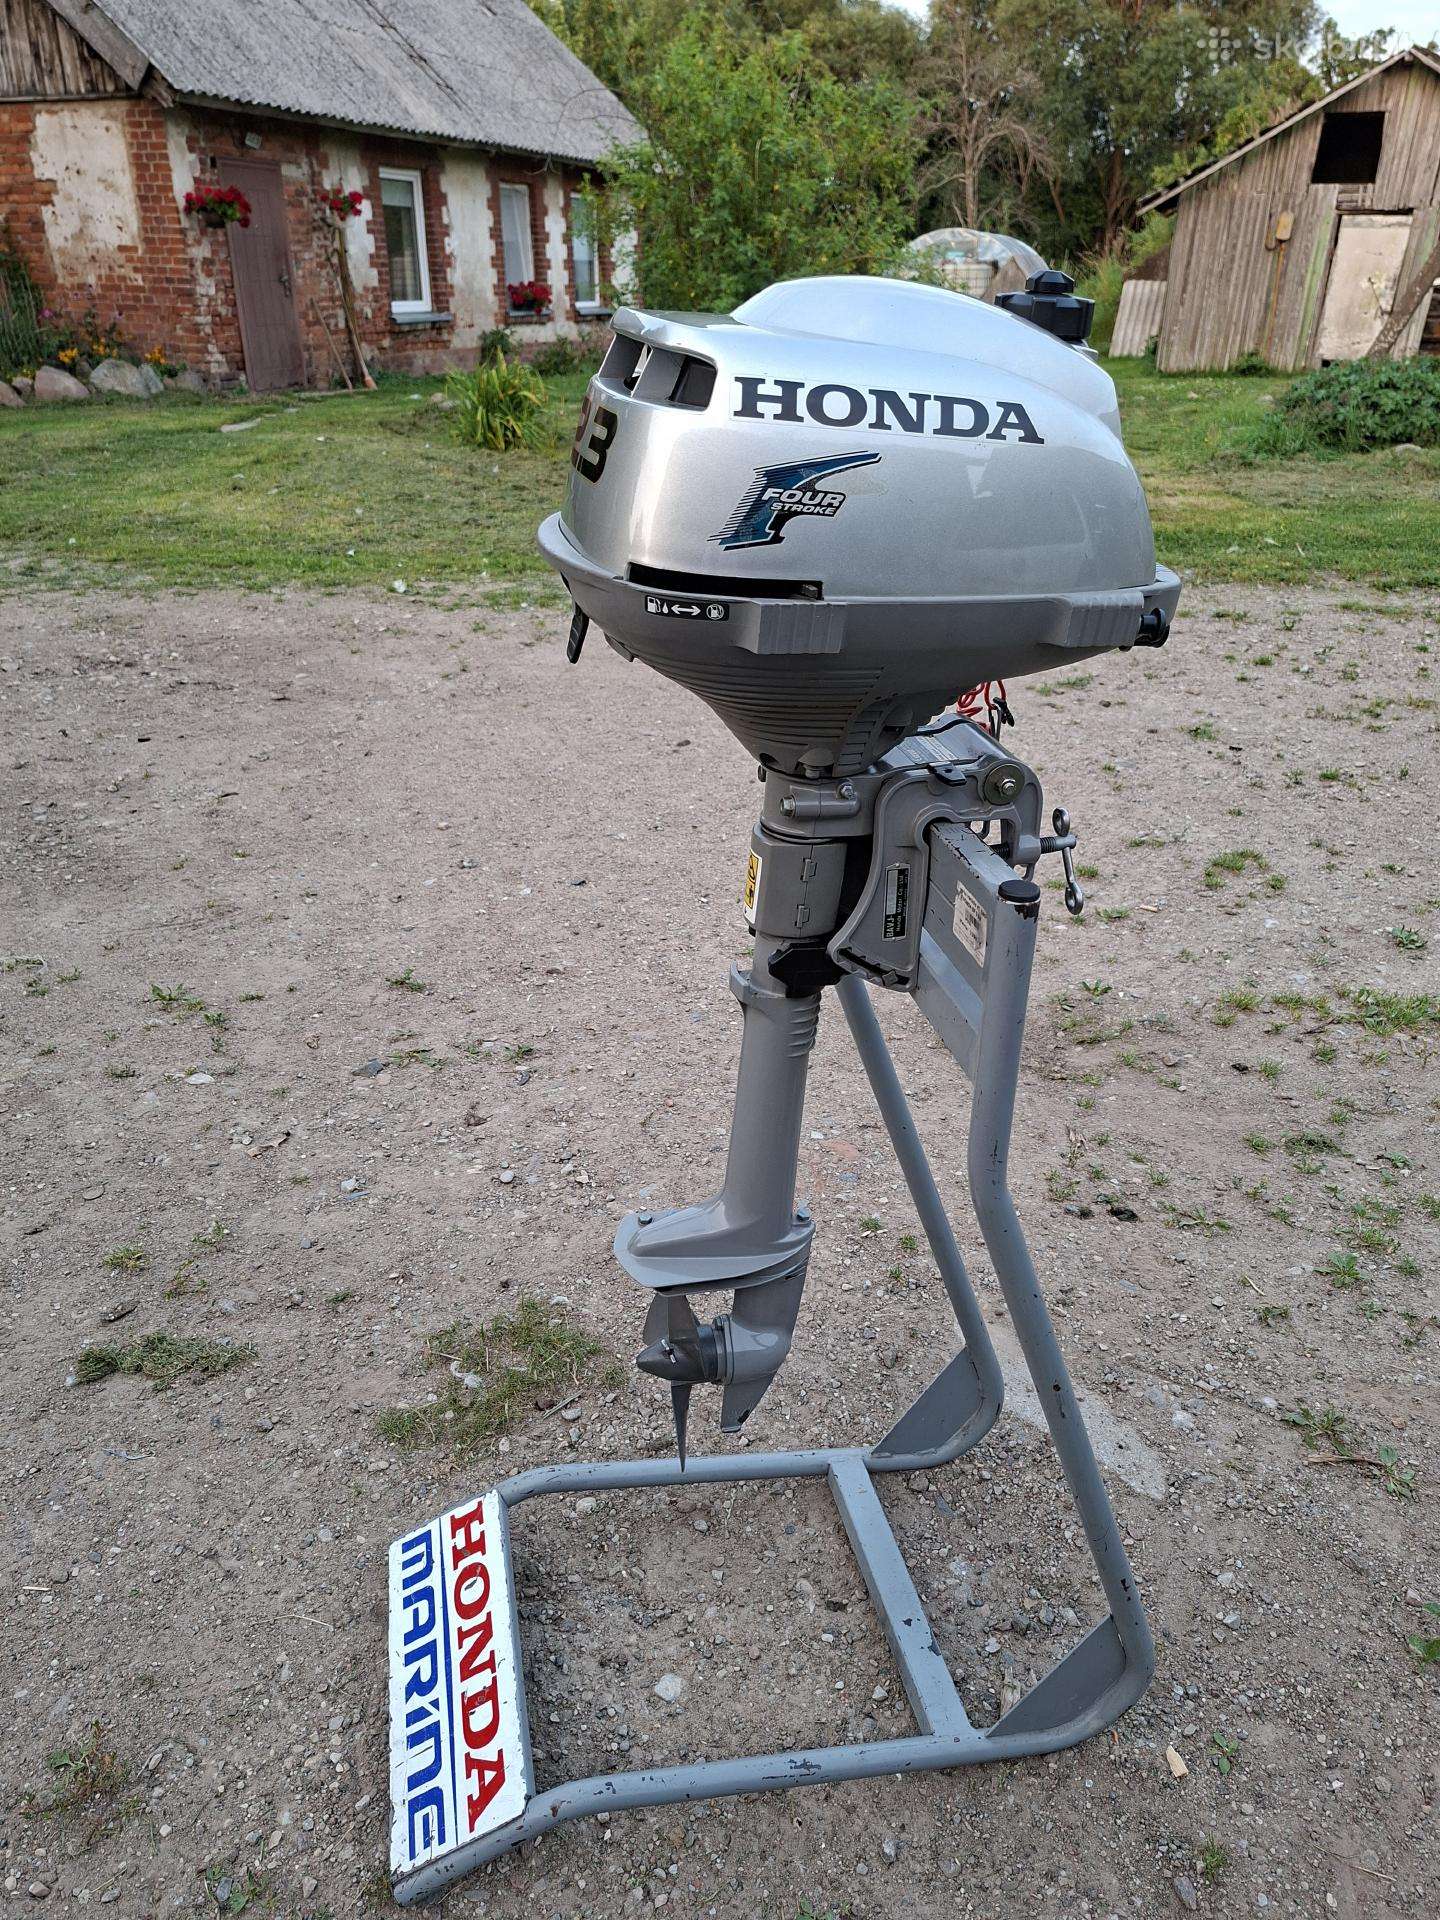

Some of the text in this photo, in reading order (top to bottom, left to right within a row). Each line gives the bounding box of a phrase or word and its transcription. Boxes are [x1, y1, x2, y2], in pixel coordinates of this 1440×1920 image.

[733, 376, 1045, 444] HONDA
[761, 488, 844, 507] FOUR
[771, 502, 837, 515] STROKE
[450, 1501, 506, 1833] HONDA
